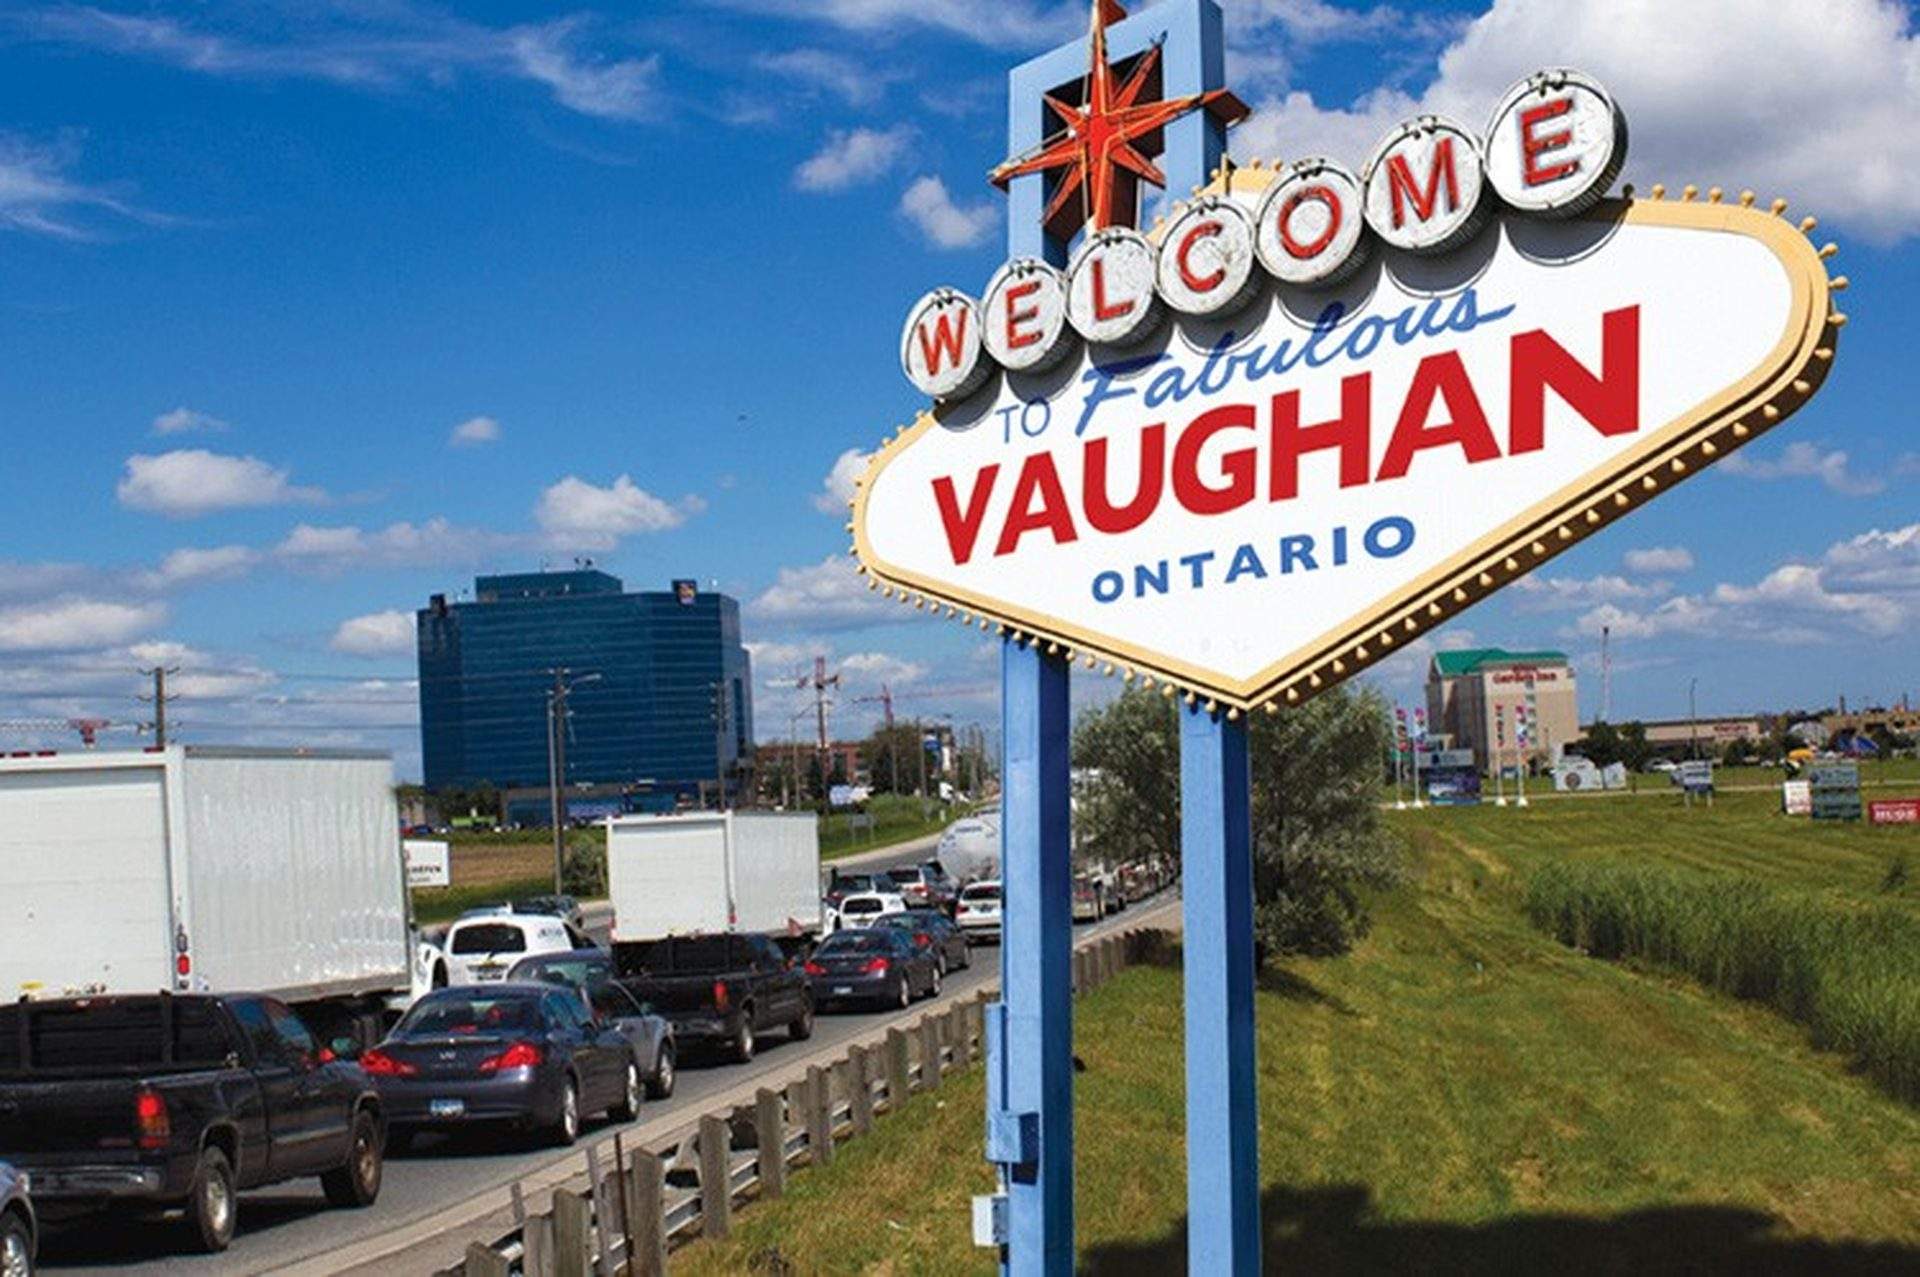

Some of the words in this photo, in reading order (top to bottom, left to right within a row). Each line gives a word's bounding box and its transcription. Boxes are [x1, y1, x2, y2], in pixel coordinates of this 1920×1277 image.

[917, 98, 1577, 379] WELCOME
[930, 304, 1641, 566] VAUGHAN
[995, 397, 1051, 444] TO
[1075, 287, 1516, 438] Fabulous
[1091, 514, 1417, 605] ONTARIO
